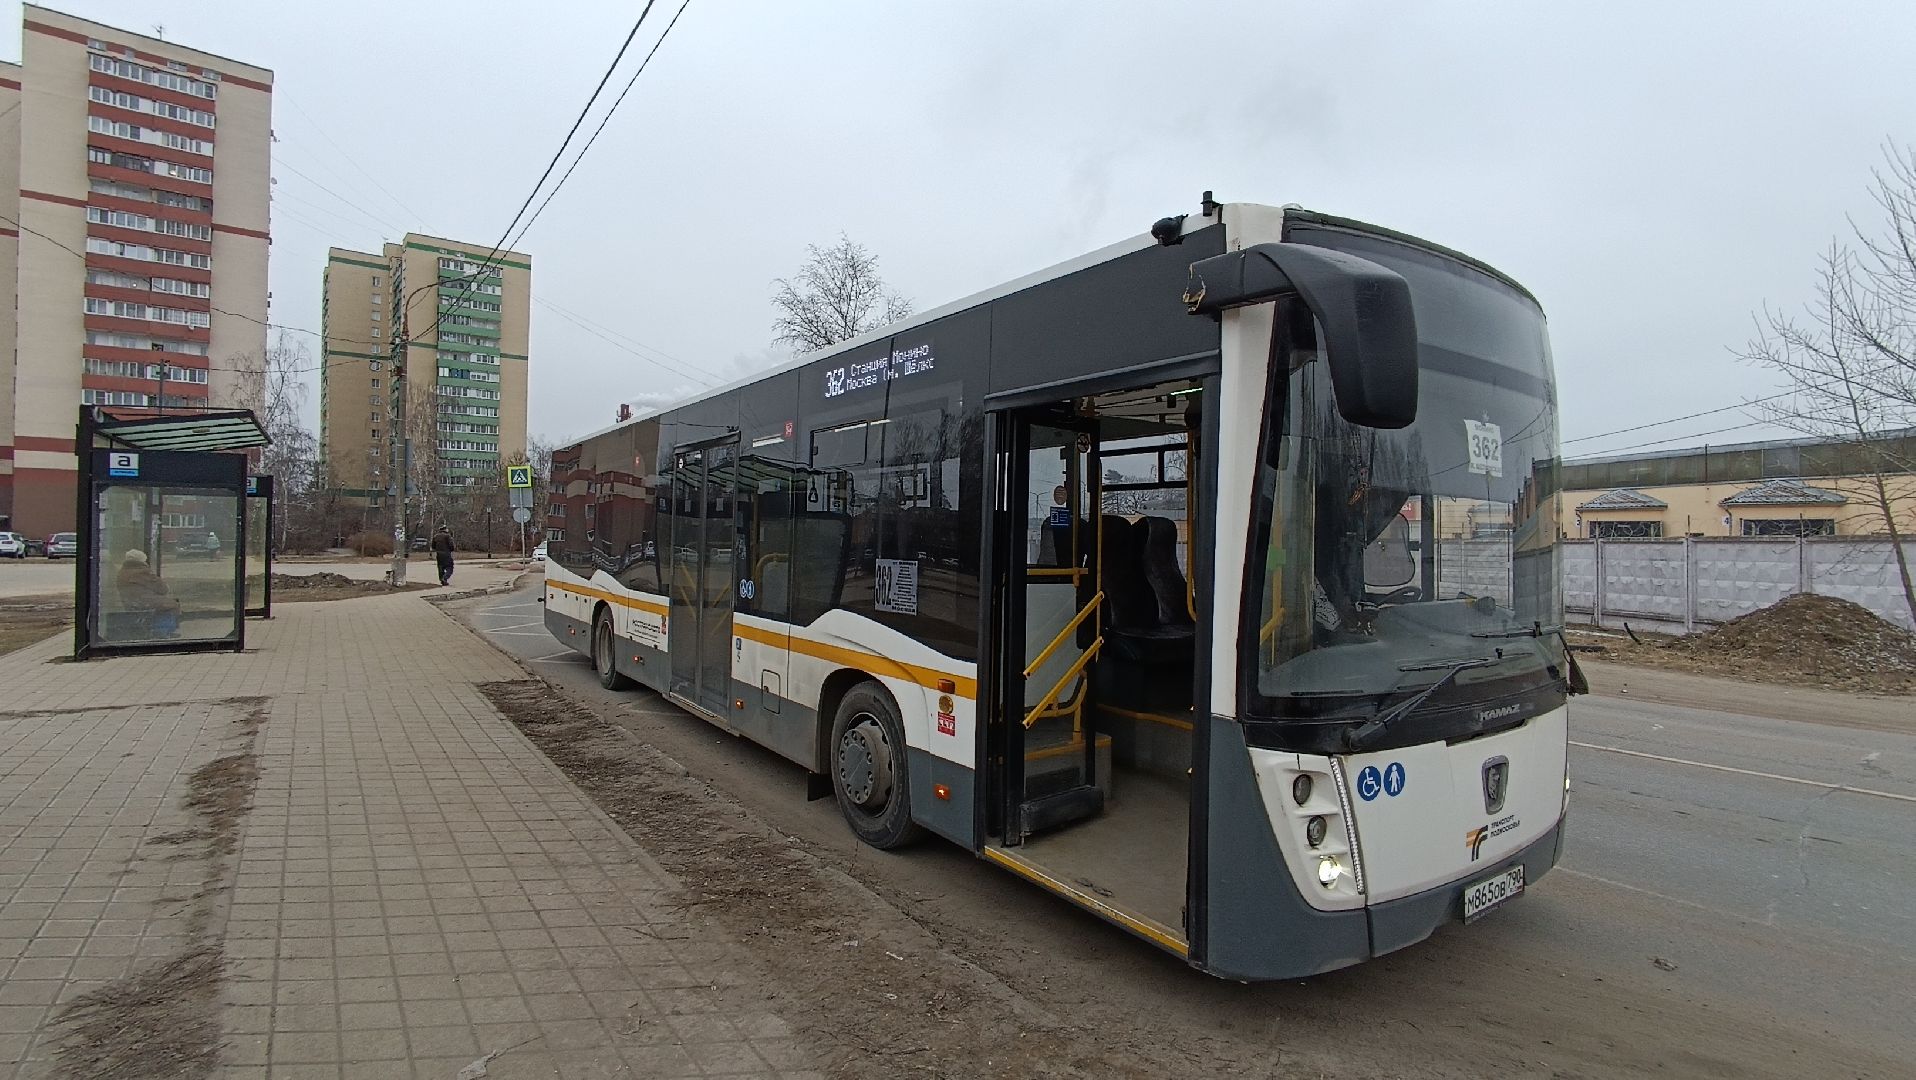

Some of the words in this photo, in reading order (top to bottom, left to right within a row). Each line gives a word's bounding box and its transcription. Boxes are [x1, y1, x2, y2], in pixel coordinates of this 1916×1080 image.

[850, 357, 888, 377] Станция
[892, 345, 930, 365] Монино
[824, 367, 845, 398] 362
[846, 374, 878, 391] Москва
[1472, 434, 1499, 462] 362
[875, 564, 892, 605] 362
[1479, 703, 1520, 721] KAMAZ
[1508, 868, 1521, 889] 790
